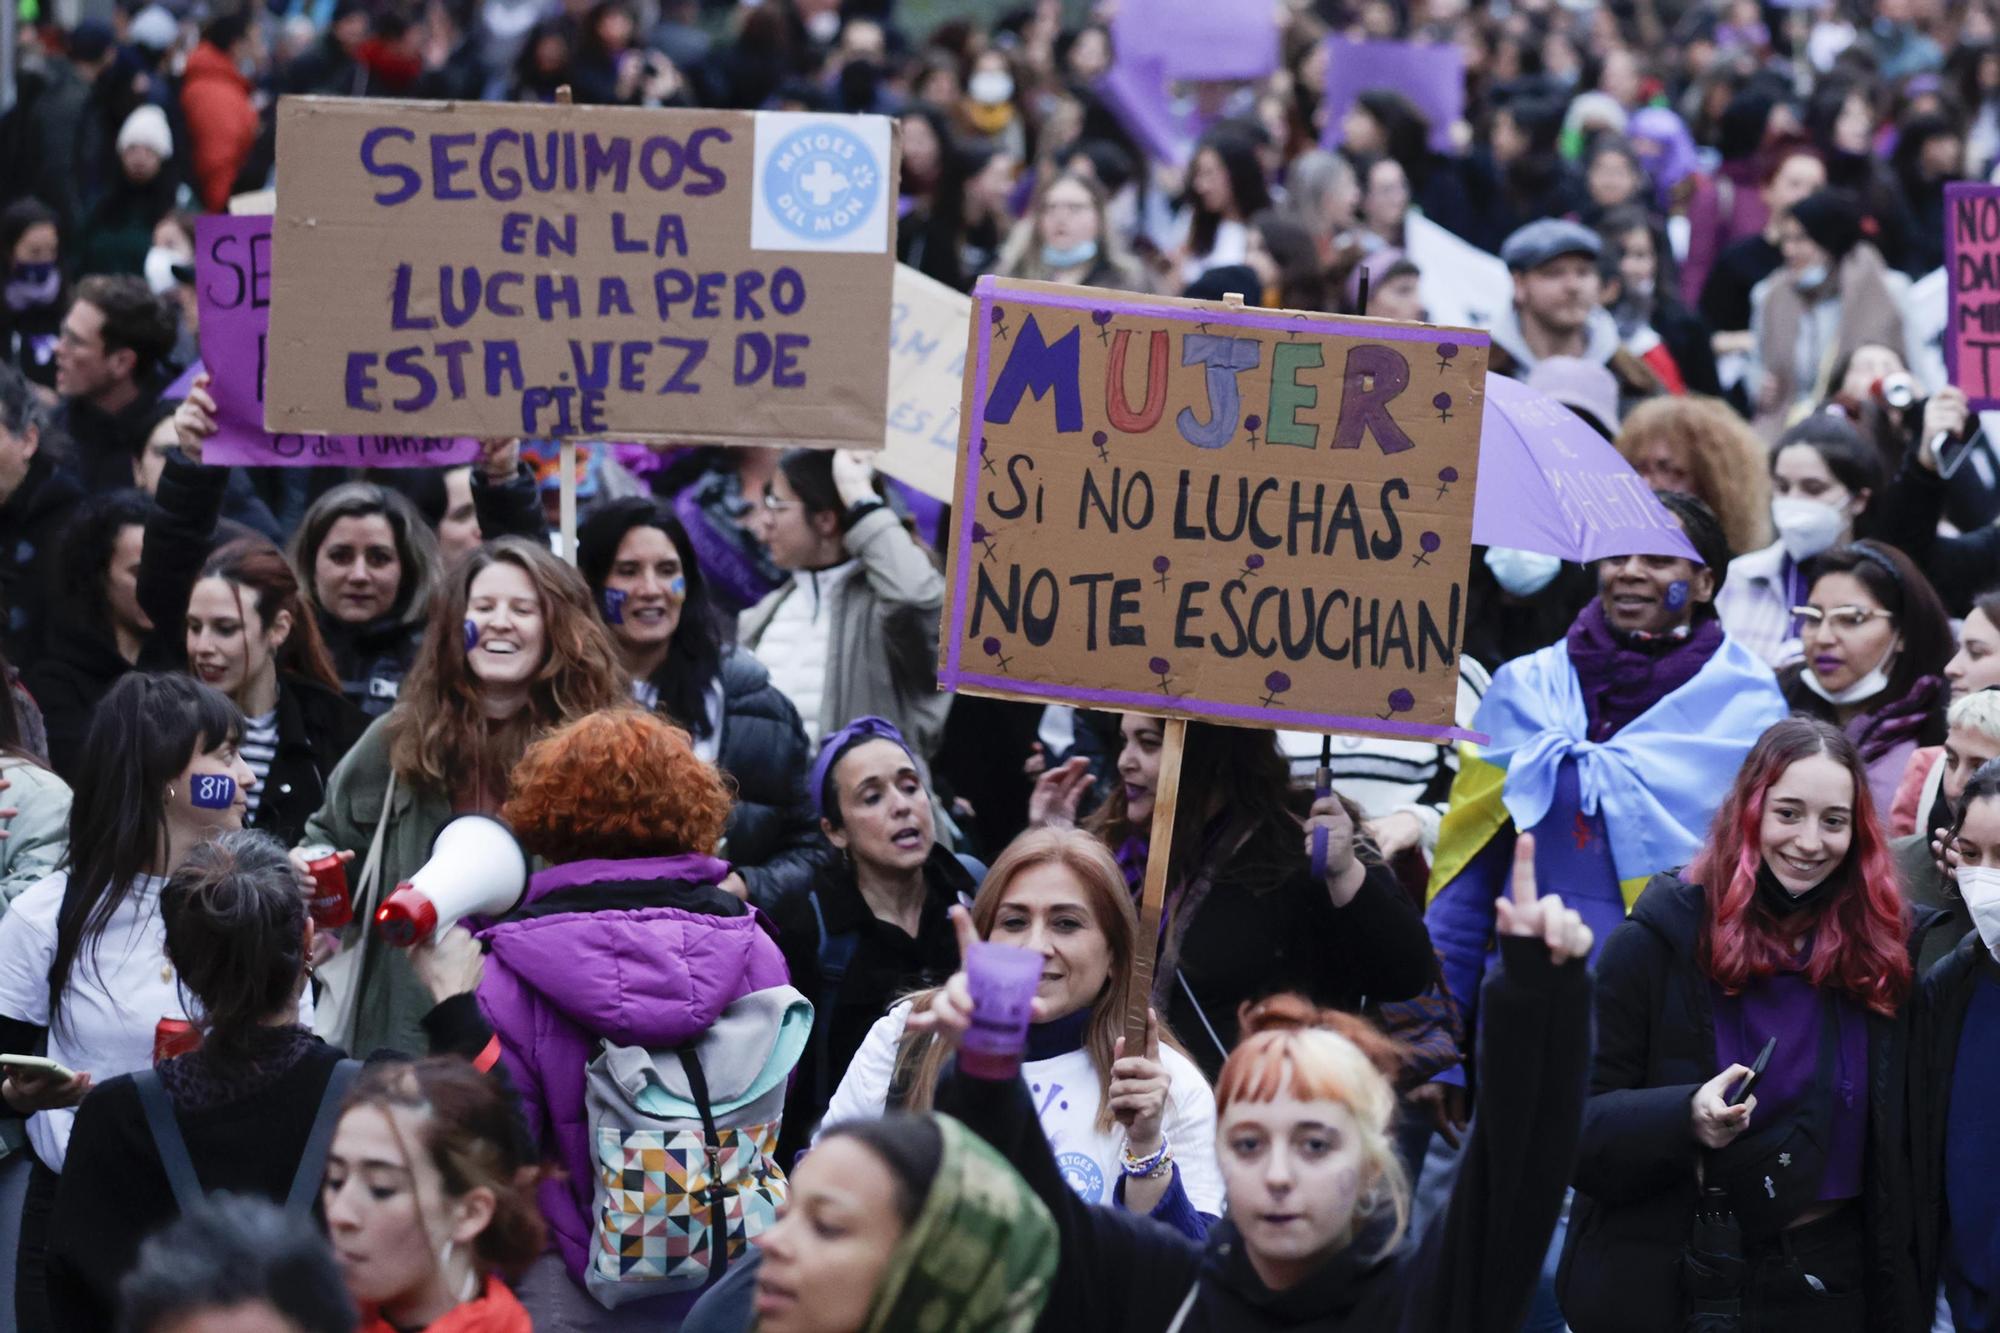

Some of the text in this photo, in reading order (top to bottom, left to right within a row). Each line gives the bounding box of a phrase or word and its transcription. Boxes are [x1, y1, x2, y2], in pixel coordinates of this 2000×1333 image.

[360, 126, 732, 206] SEGUIMOS
[778, 134, 857, 172] METGES
[501, 212, 688, 257] EN LA
[778, 193, 806, 228] DEL
[391, 261, 806, 331] LUCHA PERO
[345, 330, 811, 414] ESTA VEZ DE
[521, 371, 608, 436] PIE
[984, 313, 1415, 455] MUJER
[1078, 467, 1154, 533] NO
[1173, 469, 1410, 561] LUCHAS
[969, 562, 1460, 673] NO TE ESCUCHAN
[200, 776, 230, 800] 8M
[1059, 1156, 1093, 1171] ETGES
